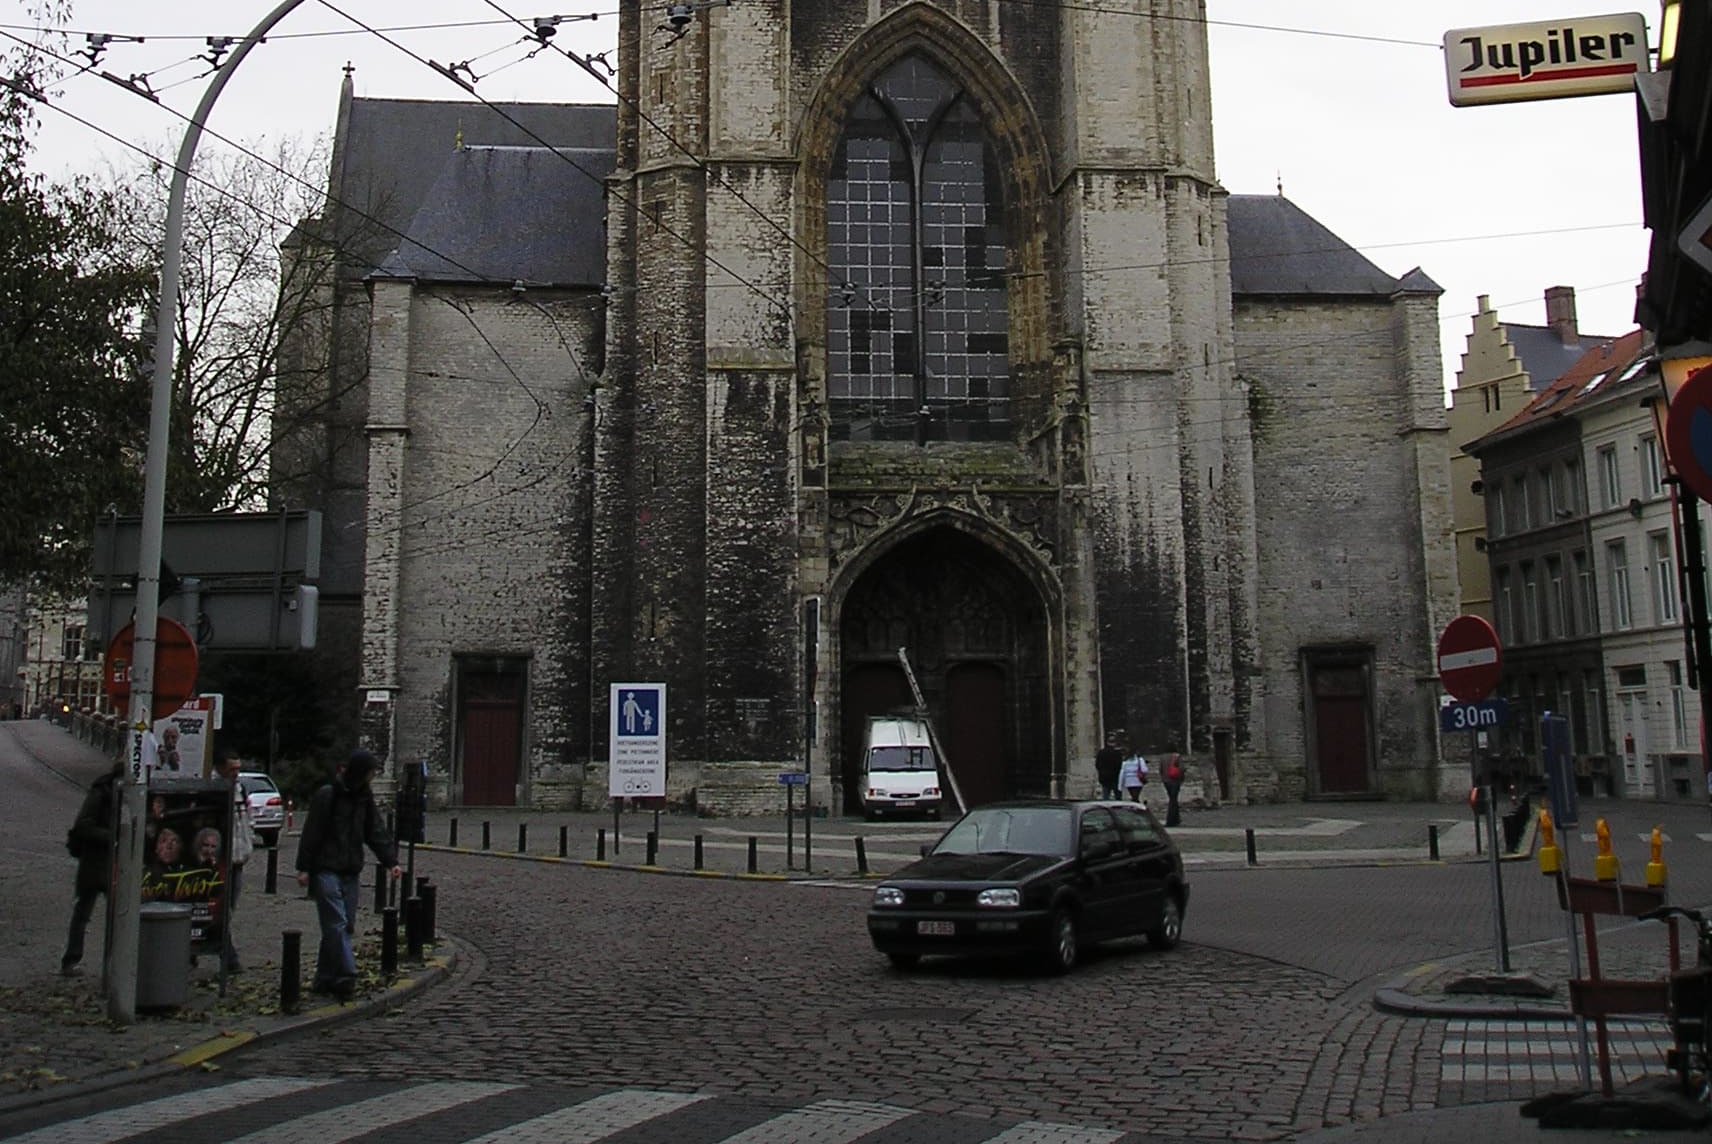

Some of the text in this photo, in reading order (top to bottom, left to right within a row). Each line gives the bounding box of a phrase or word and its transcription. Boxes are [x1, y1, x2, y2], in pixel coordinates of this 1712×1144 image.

[1459, 27, 1635, 77] Jupiler
[1453, 705, 1497, 728] 30m
[161, 868, 225, 899] Twist
